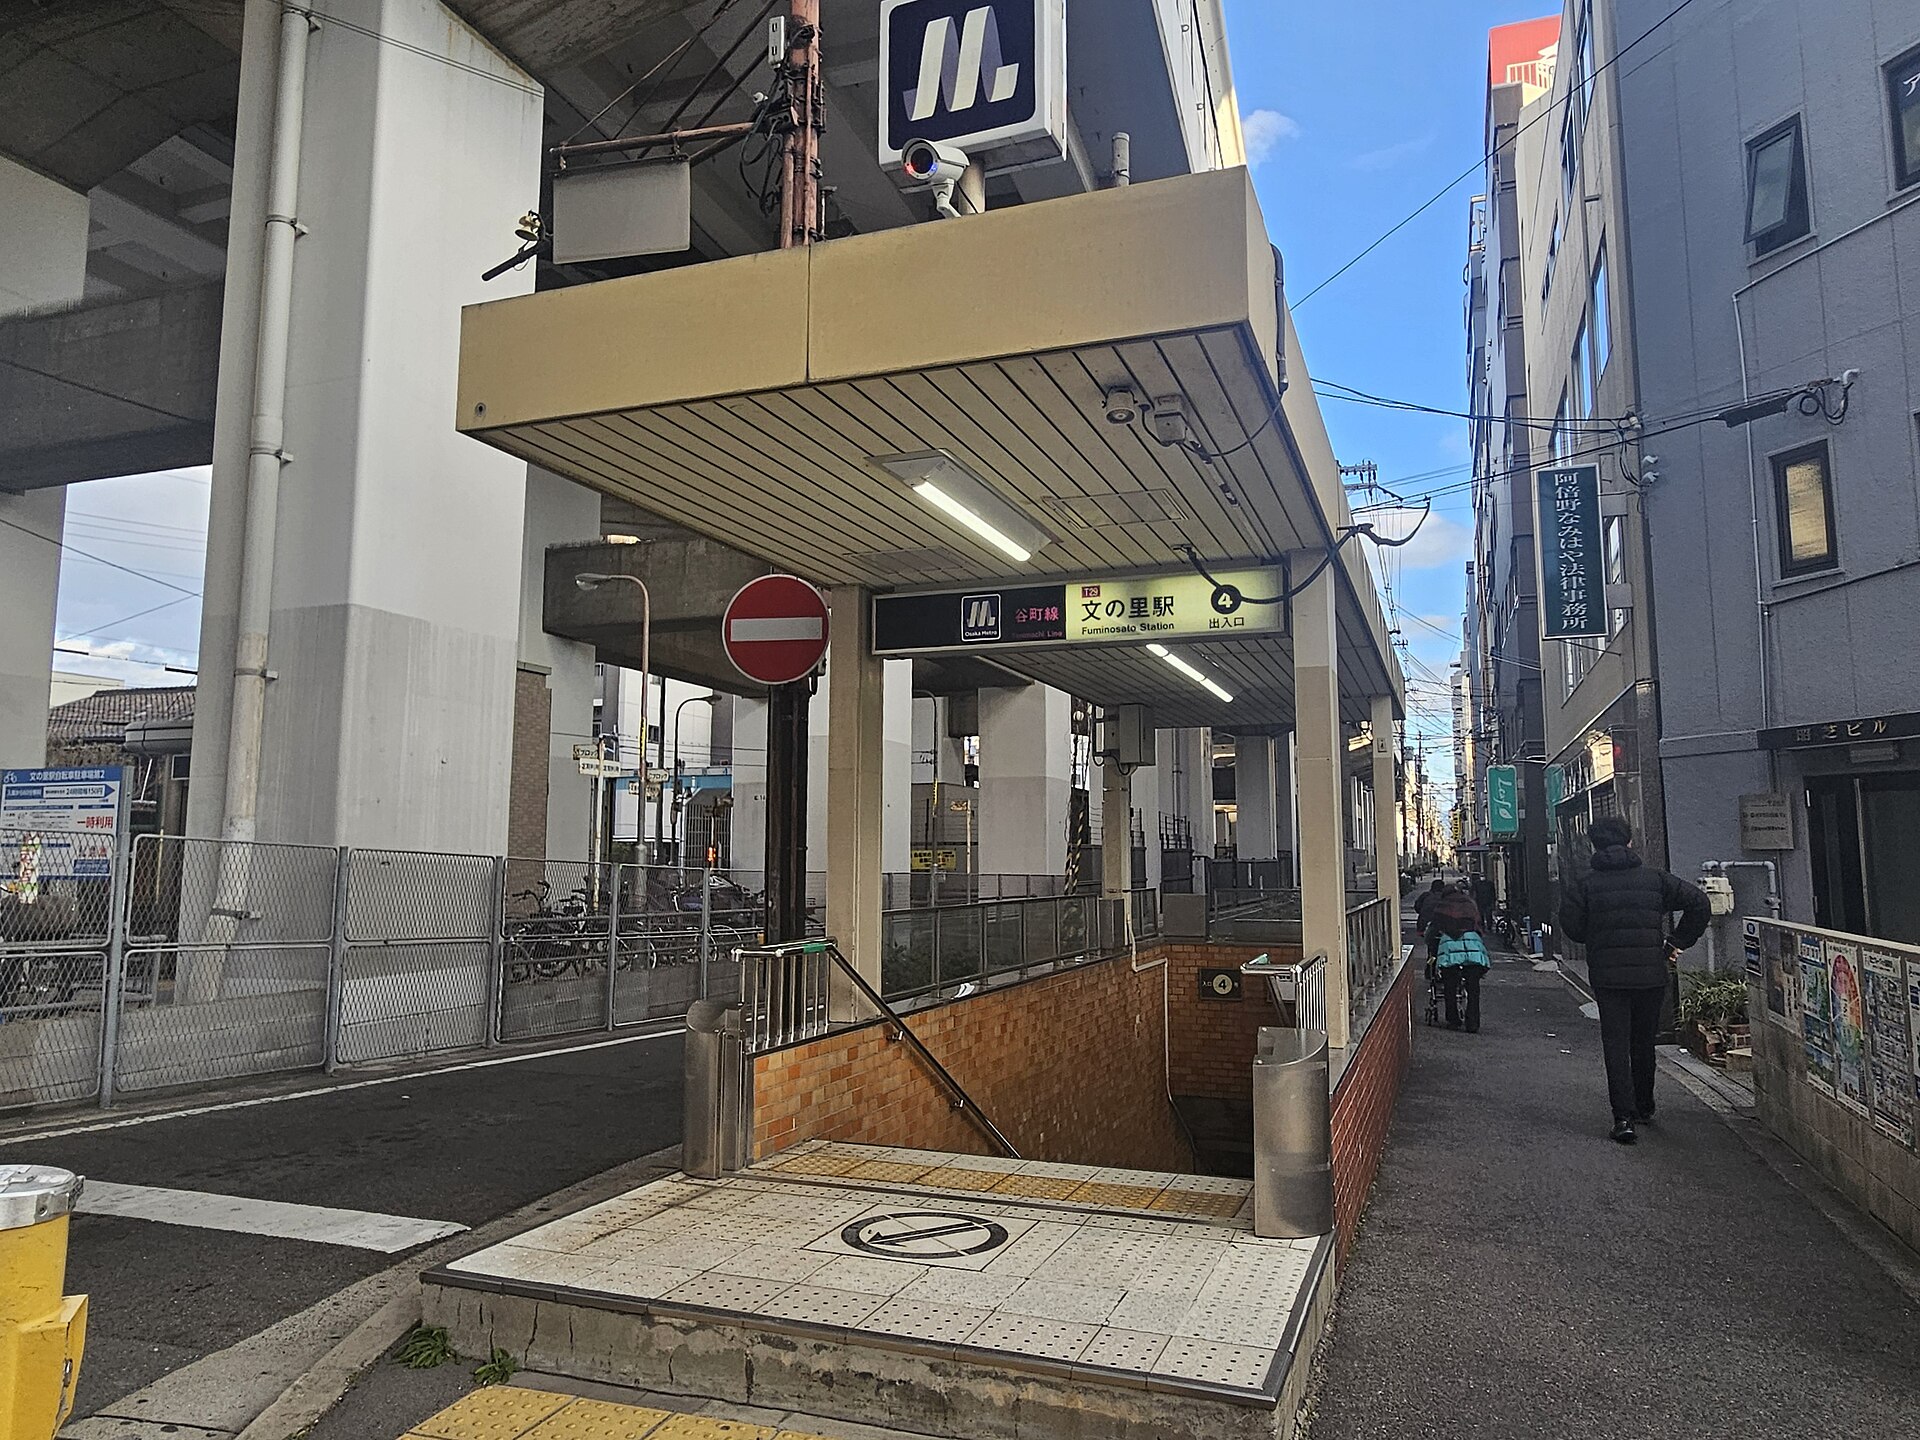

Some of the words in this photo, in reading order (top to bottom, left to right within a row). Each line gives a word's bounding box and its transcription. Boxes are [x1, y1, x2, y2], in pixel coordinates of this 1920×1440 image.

[1554, 472, 1588, 630] 阿倍野なみはや法律事務所
[1083, 587, 1099, 597] T29
[1217, 592, 1234, 608] 4
[1014, 605, 1060, 623] 谷町線
[1081, 595, 1175, 622] 文の里駅
[1081, 625, 1137, 636] Fuminosato
[1139, 622, 1175, 633] Station
[1208, 616, 1245, 629] 出入口
[1493, 777, 1513, 810] Leaf
[77, 816, 114, 829] 一時利用
[1218, 979, 1227, 990] 4
